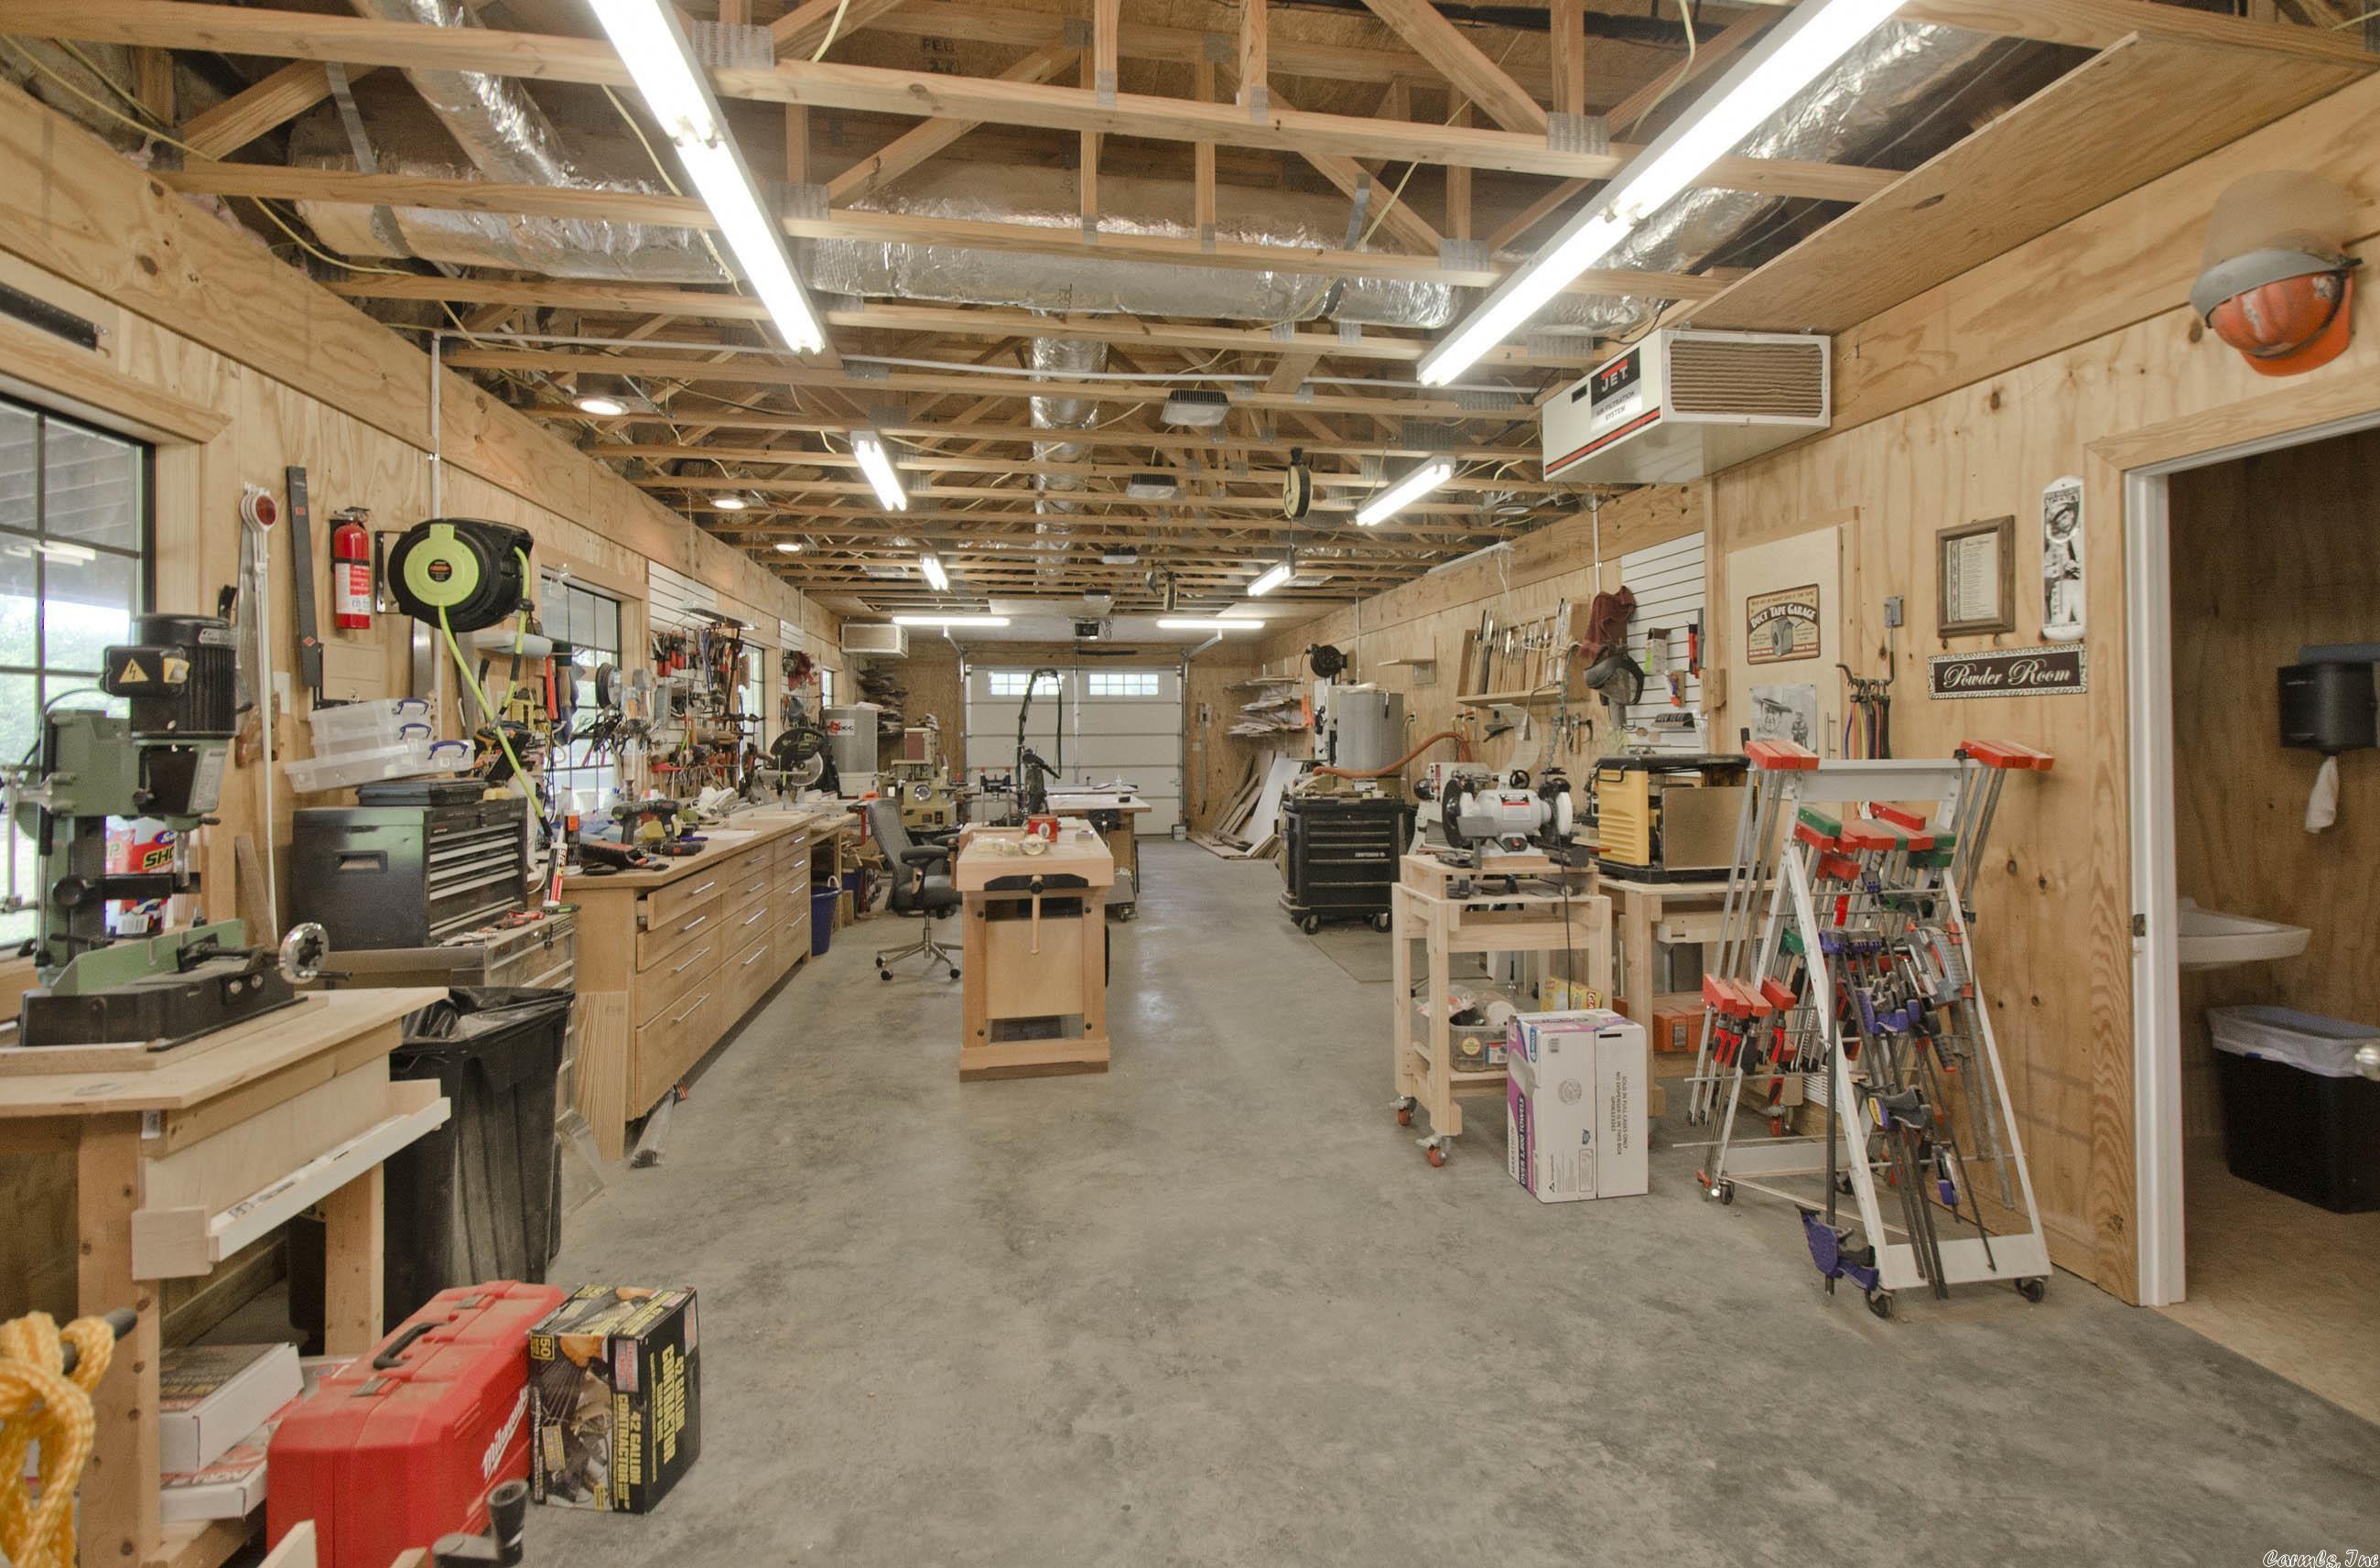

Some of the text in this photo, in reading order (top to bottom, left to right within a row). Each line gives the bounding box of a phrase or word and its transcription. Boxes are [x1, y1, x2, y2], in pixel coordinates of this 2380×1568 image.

[1601, 363, 1628, 392] JET
[1606, 405, 1626, 421] SYSTEM
[1750, 603, 1817, 629] DUCT TAPE GARAGE
[1942, 658, 2071, 688] Powder Room
[540, 1336, 551, 1357] 50
[662, 1344, 676, 1465] CONTRACTOR
[674, 1355, 686, 1433] 42 GALLON
[617, 1393, 630, 1482] CONTRACTOR
[629, 1411, 641, 1485] 42 GALLON
